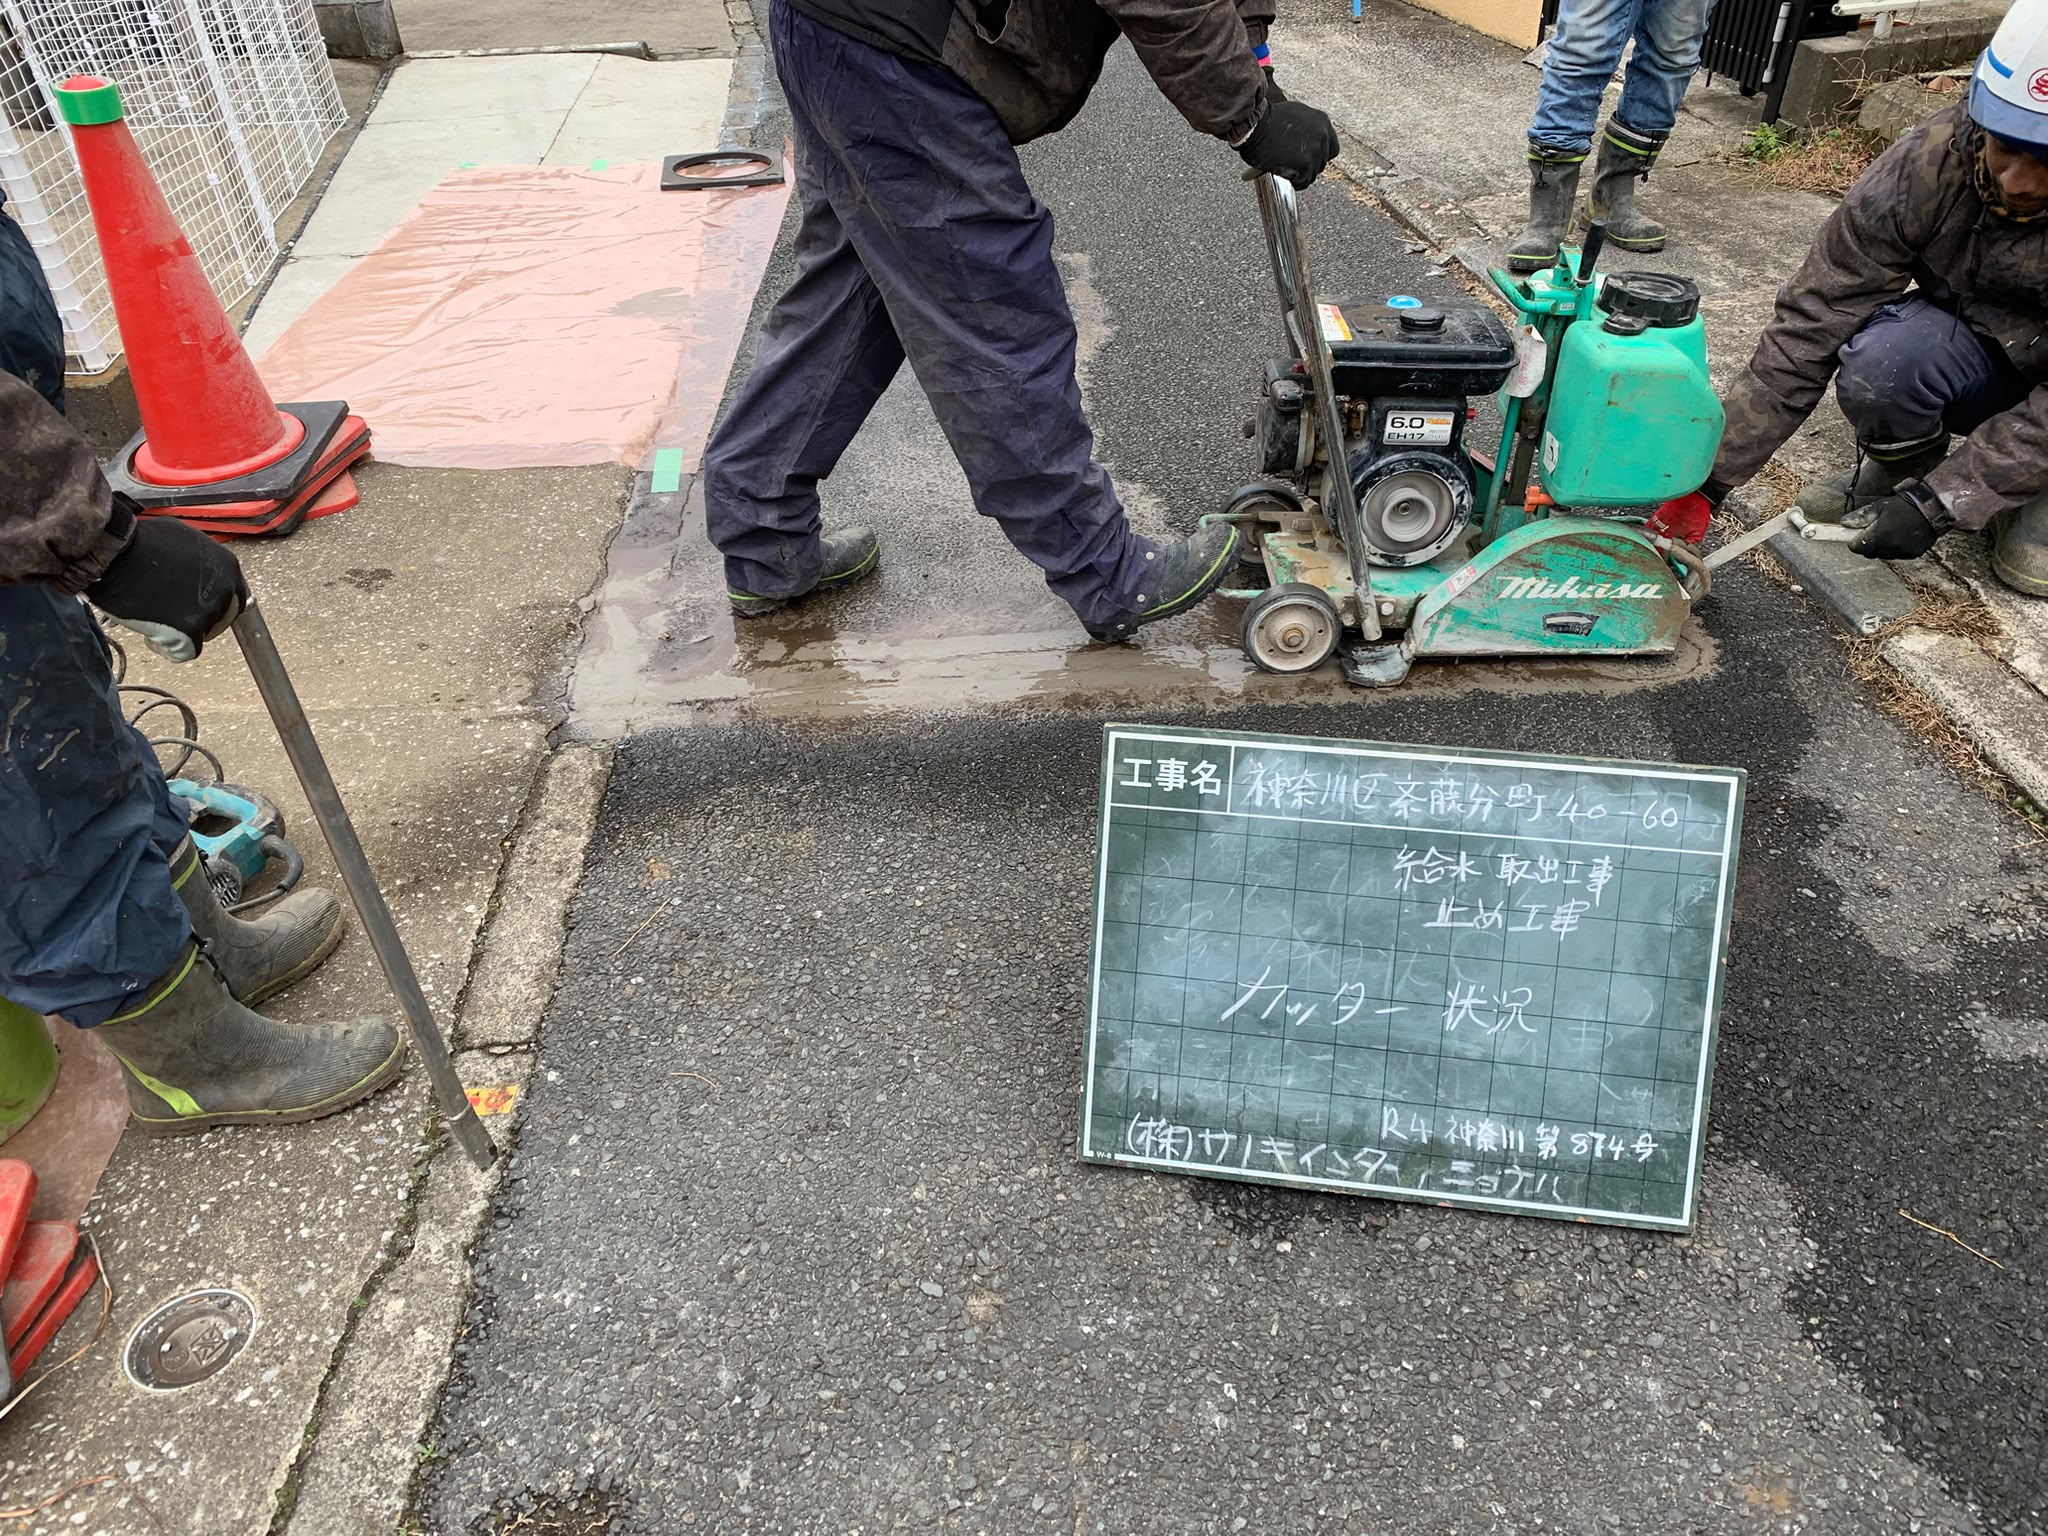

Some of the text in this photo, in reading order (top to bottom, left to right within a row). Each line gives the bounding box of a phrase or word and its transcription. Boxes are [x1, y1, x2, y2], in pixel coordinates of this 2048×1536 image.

[1390, 416, 1425, 429] 6.0
[1387, 432, 1425, 441] EH17
[1496, 576, 1663, 600] Mikasa
[1120, 757, 1223, 796] 工事名
